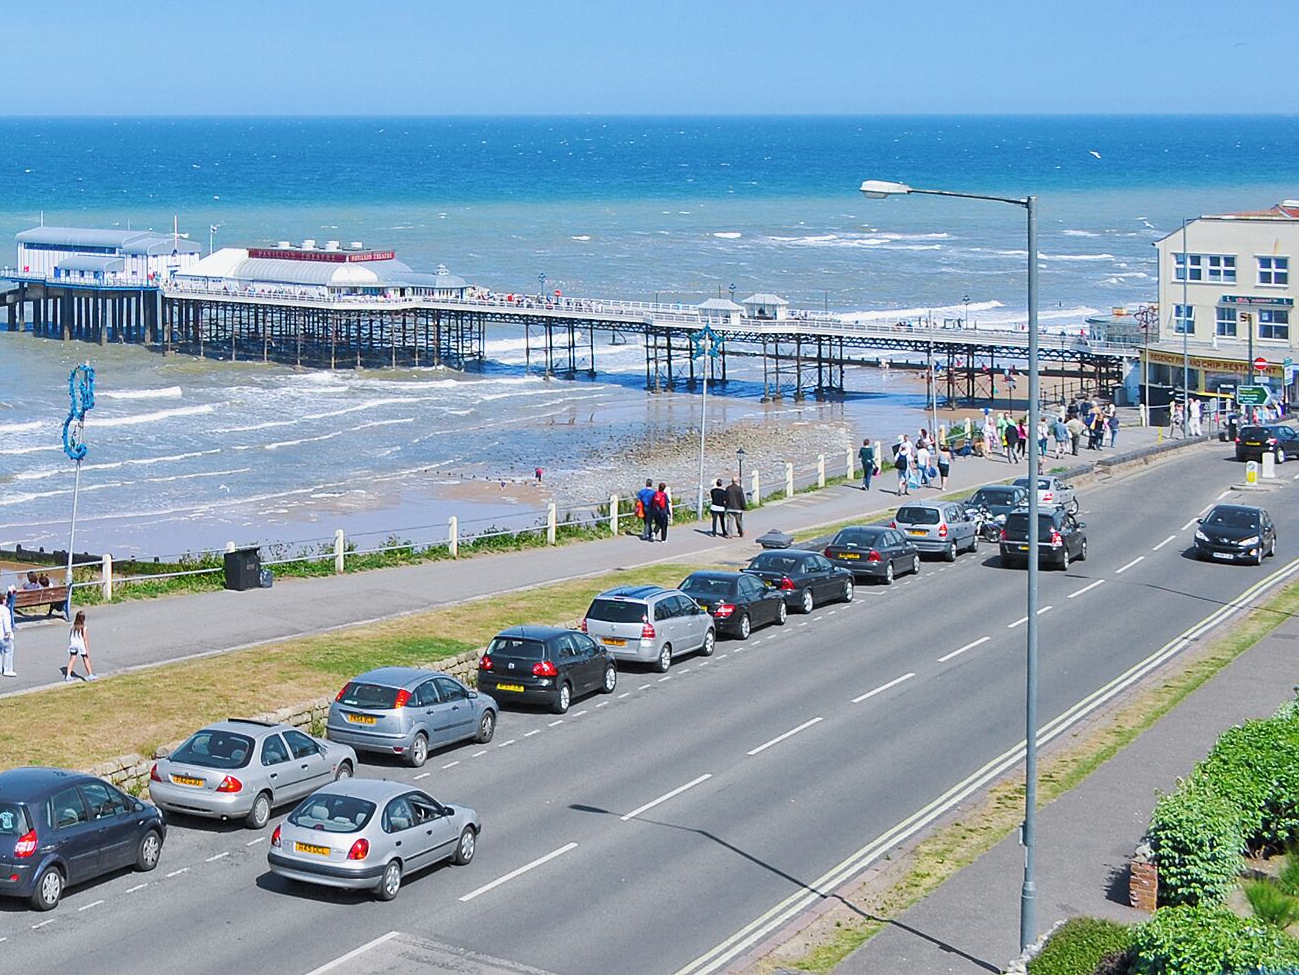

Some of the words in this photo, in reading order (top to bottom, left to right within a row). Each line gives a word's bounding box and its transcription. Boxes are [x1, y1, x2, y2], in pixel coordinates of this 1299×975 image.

[258, 250, 296, 259] PAVILION
[301, 253, 336, 261] THEATRE
[1202, 360, 1221, 370] CHIP
